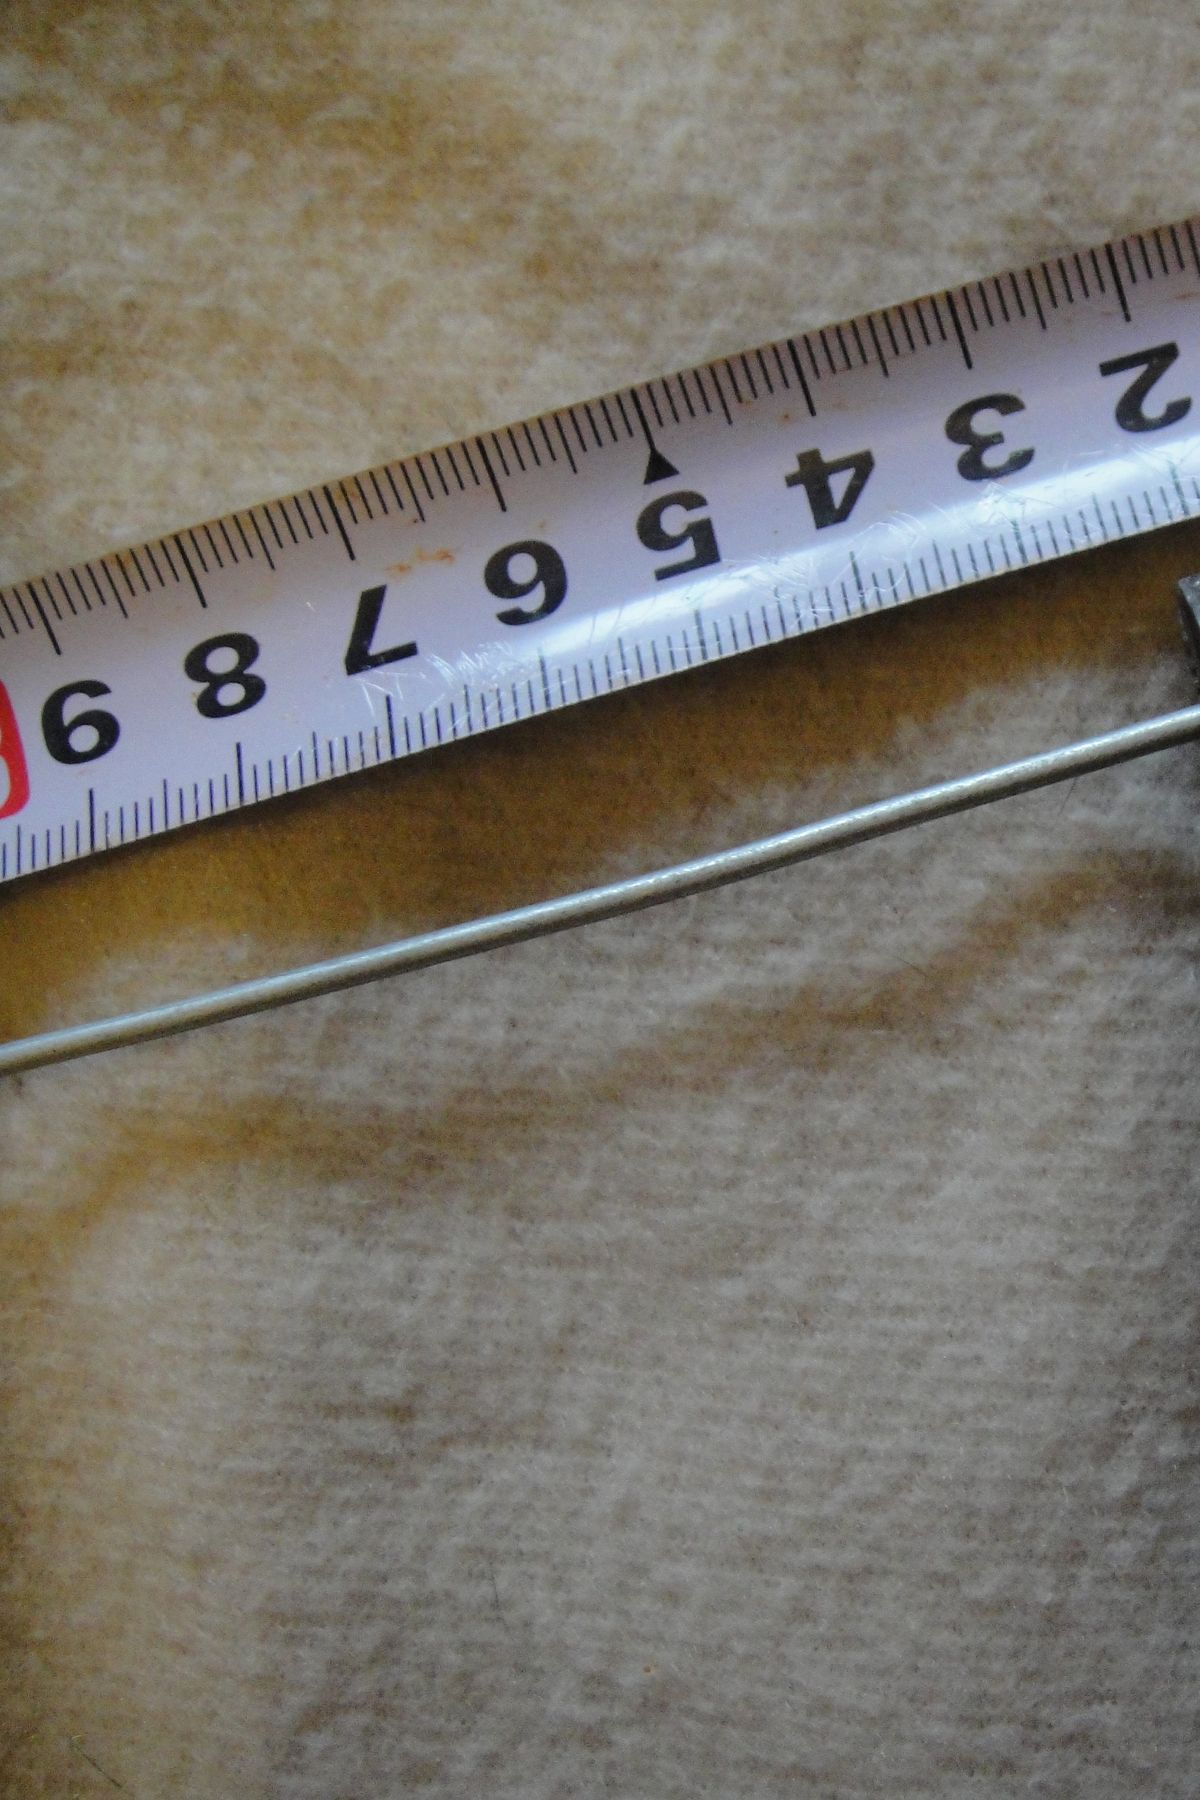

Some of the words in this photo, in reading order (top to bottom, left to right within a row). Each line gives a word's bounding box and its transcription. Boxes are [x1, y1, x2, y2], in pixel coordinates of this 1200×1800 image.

[1098, 341, 1192, 433] 2
[944, 393, 1035, 482] 3
[784, 447, 876, 530] 4
[636, 490, 722, 582] 5
[483, 540, 568, 626] 6
[344, 584, 418, 676] 7
[183, 632, 267, 719] 8
[41, 679, 121, 765] 9
